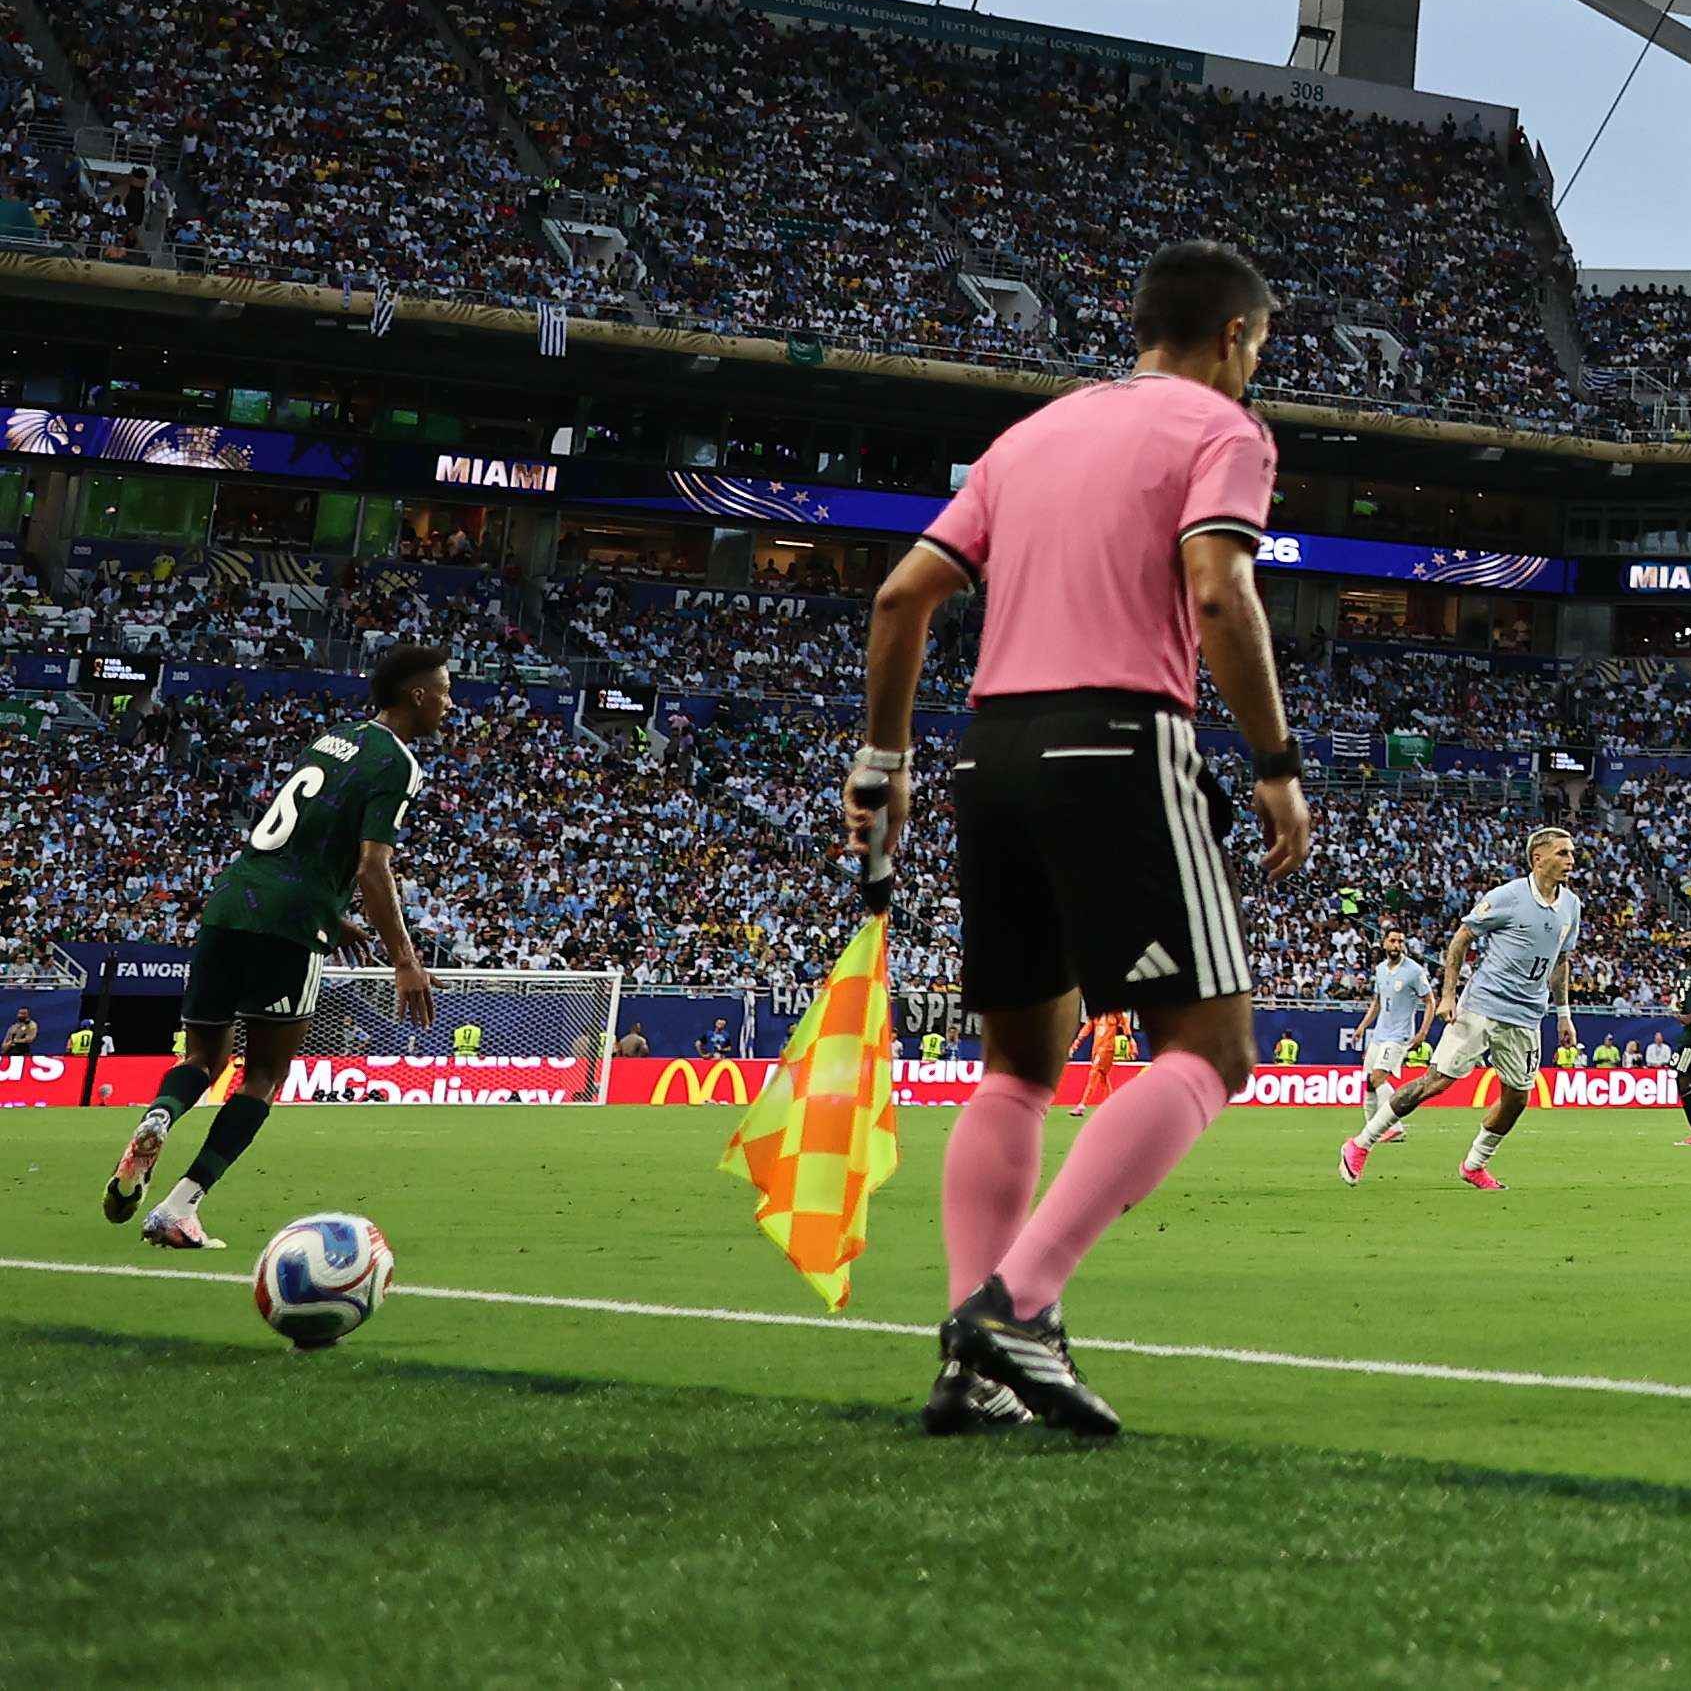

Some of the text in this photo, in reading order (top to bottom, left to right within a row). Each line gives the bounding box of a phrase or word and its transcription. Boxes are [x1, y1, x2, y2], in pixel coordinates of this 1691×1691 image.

[872, 8, 929, 28] BEHAVIOR
[1290, 81, 1325, 102] 308
[436, 455, 557, 492] MIAMI
[251, 766, 325, 851] 6
[1528, 956, 1549, 981] 13
[1382, 1046, 1391, 1061] 6
[1525, 1049, 1541, 1075] 13
